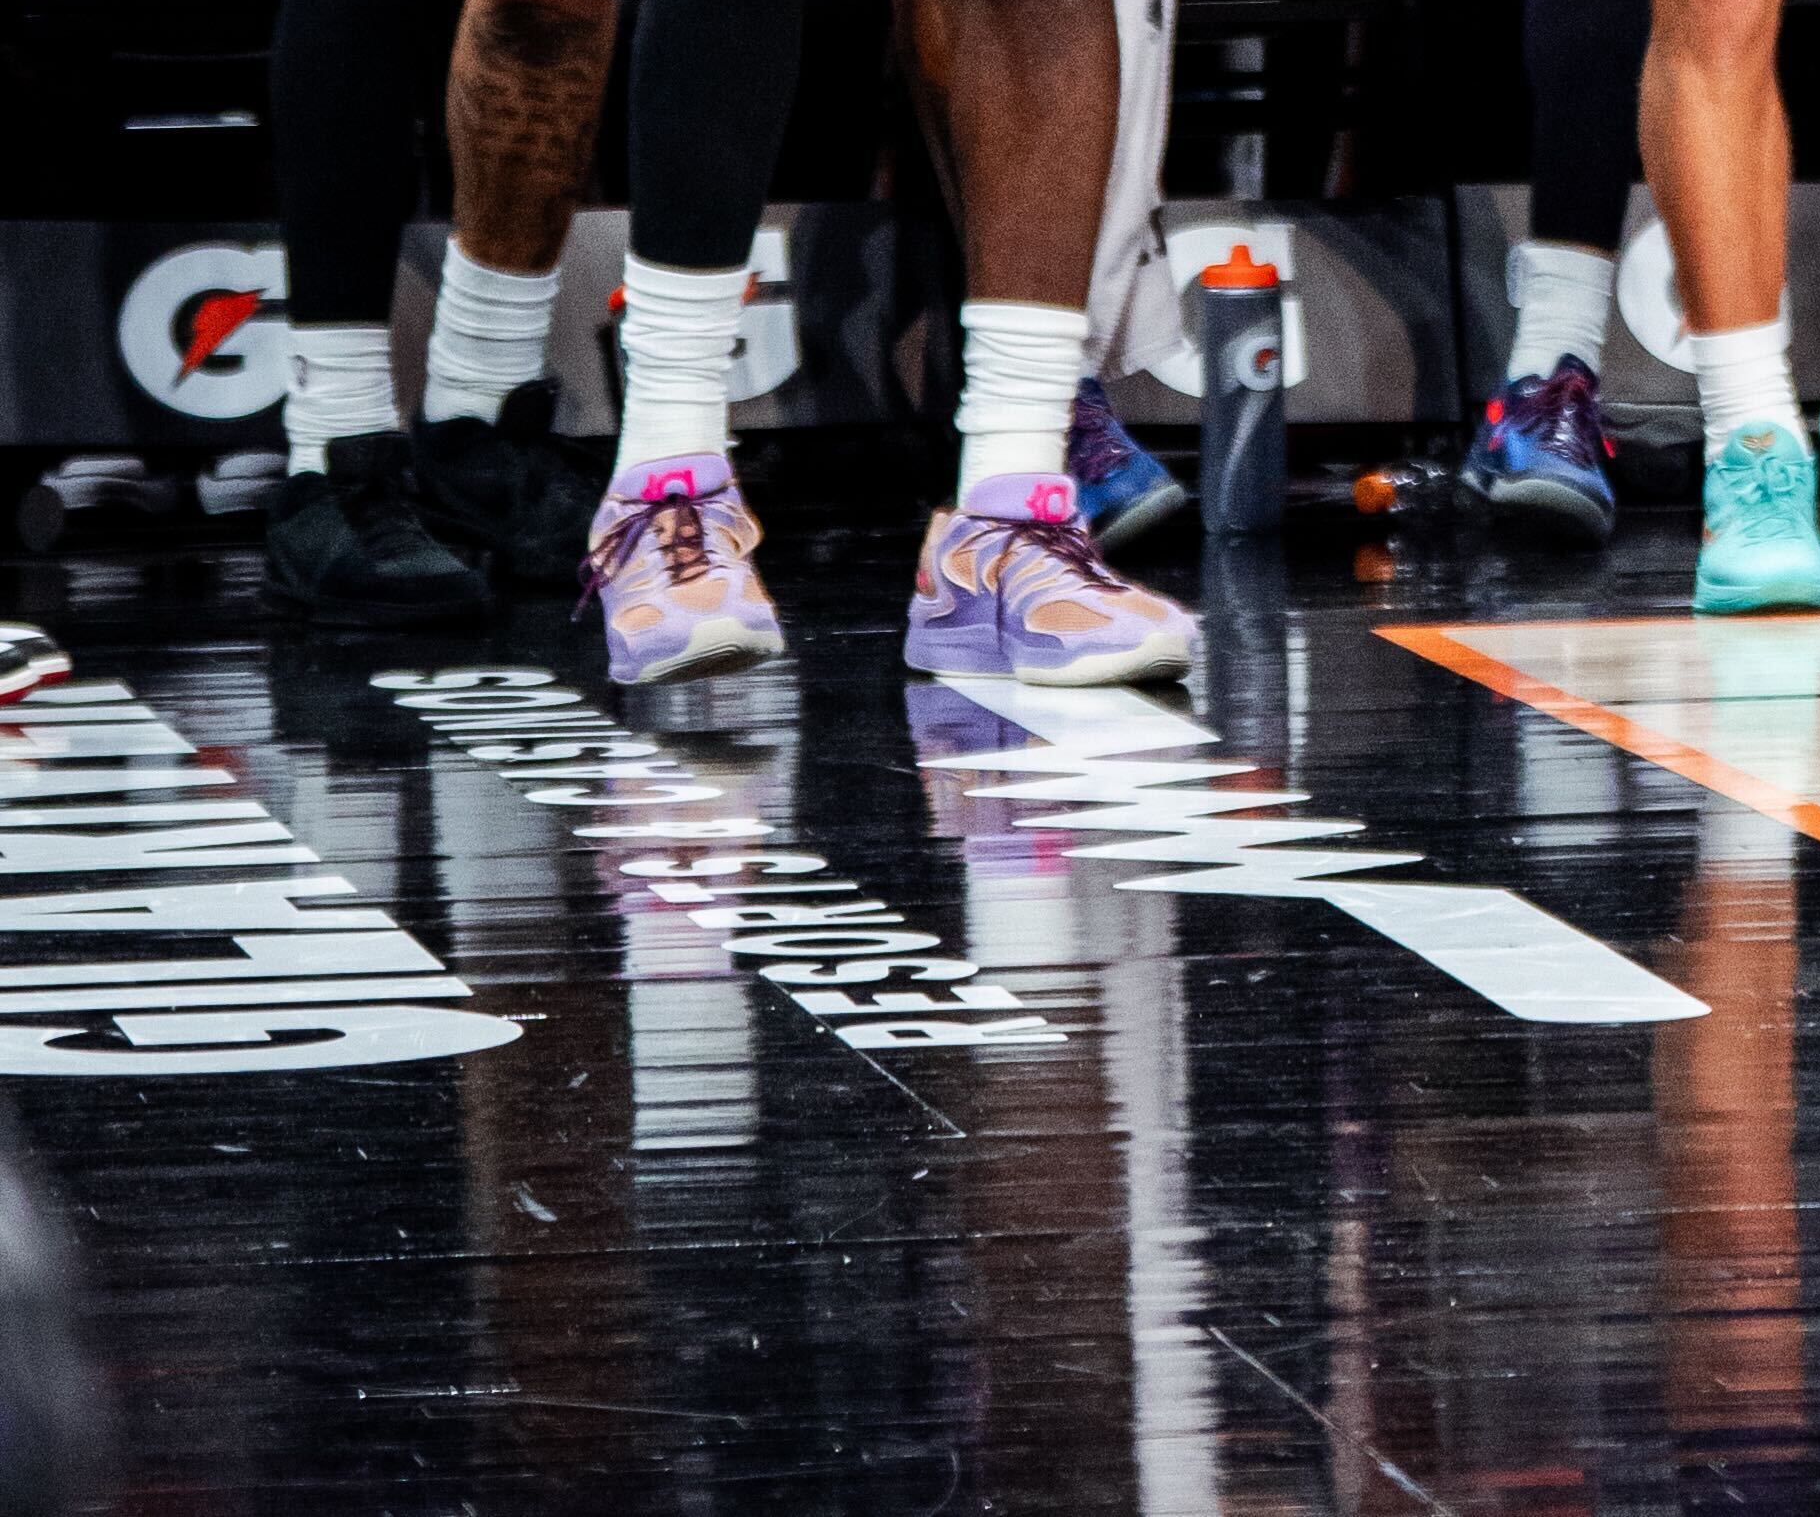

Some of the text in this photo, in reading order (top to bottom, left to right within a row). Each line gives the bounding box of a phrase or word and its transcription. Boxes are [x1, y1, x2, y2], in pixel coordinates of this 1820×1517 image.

[118, 242, 289, 420] G
[369, 670, 723, 806] CASINOS
[572, 818, 775, 839] &
[619, 855, 1068, 1050] RESORTS
